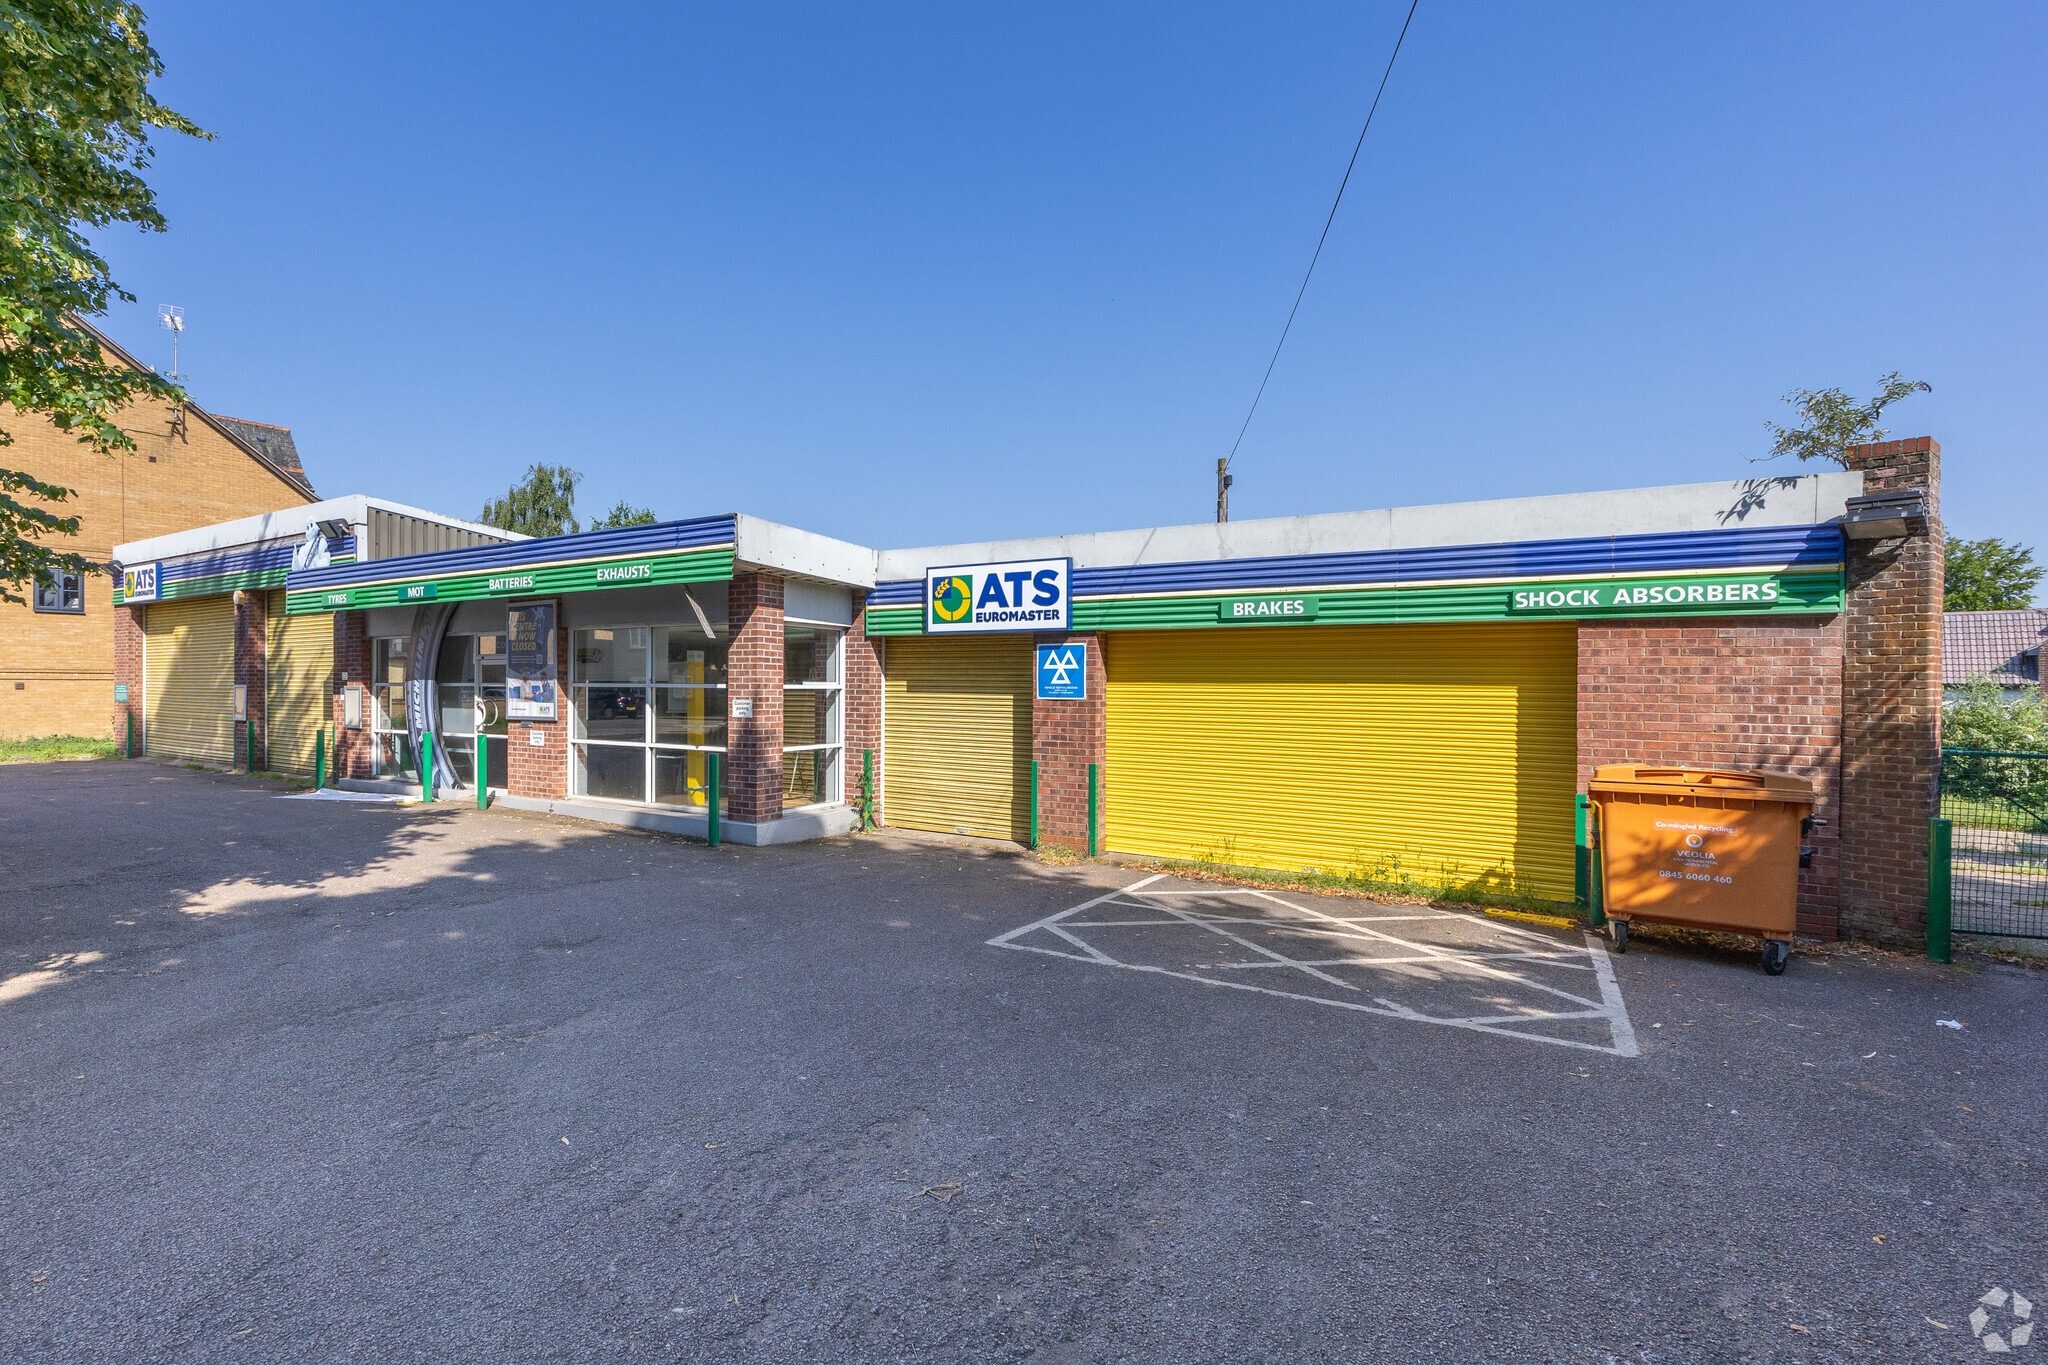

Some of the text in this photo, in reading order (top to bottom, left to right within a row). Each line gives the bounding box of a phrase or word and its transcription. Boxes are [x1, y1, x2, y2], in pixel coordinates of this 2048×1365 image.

[135, 568, 155, 589] ATS
[597, 564, 650, 581] EXHAUSTS
[488, 576, 533, 590] BATTERIES
[976, 569, 1060, 609] ATS
[327, 594, 347, 604] TYRES
[407, 586, 425, 598] MOT
[1515, 583, 1777, 608] SHOCK ABSORBERS
[1233, 600, 1304, 616] BRAKES
[975, 609, 1060, 623] EUROMASTER
[518, 631, 537, 641] NOW
[511, 641, 537, 651] CLOSED
[413, 638, 425, 729] MICHELIN
[1656, 822, 1734, 834] Co-mingled Recycling
[1676, 850, 1716, 860] VEOLIA
[1659, 870, 1733, 884] 0845 6060 460
